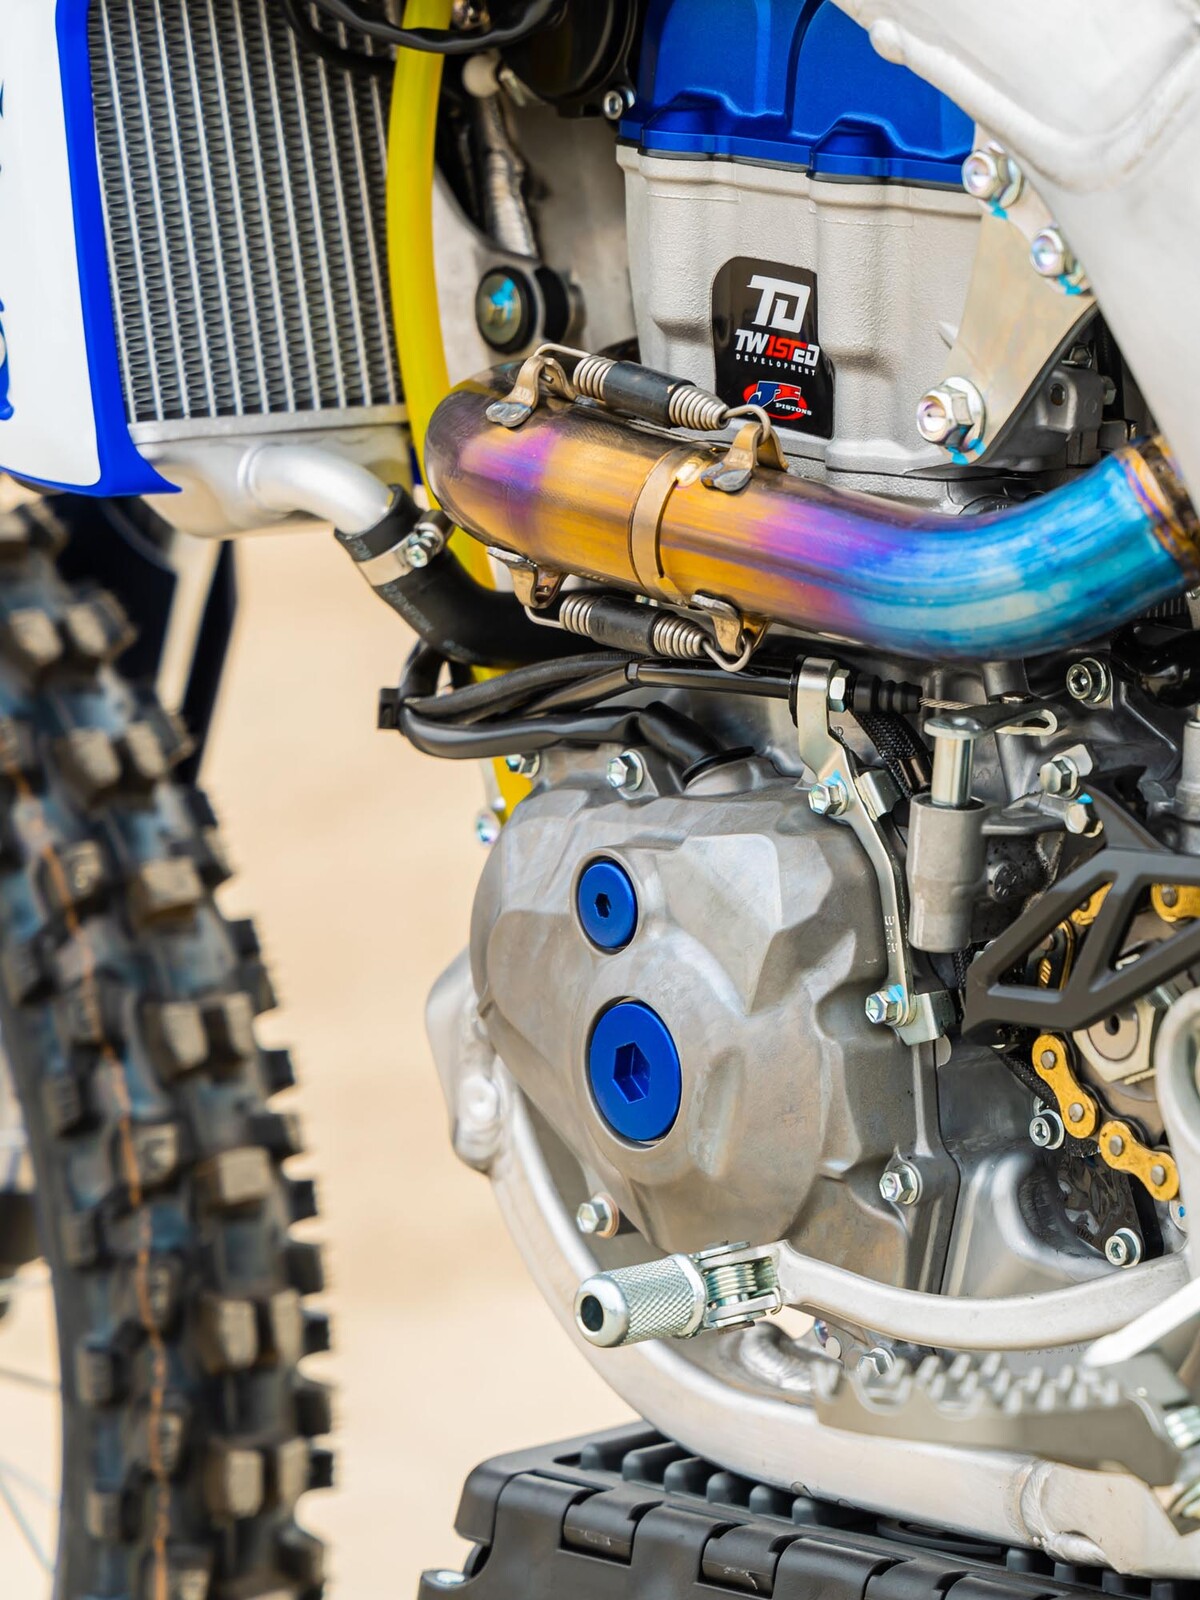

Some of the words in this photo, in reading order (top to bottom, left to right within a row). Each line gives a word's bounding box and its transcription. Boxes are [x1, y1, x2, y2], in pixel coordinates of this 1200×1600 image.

[747, 274, 811, 334] TD
[736, 353, 816, 376] DEVELOPMENT
[775, 402, 813, 416] PISTONS
